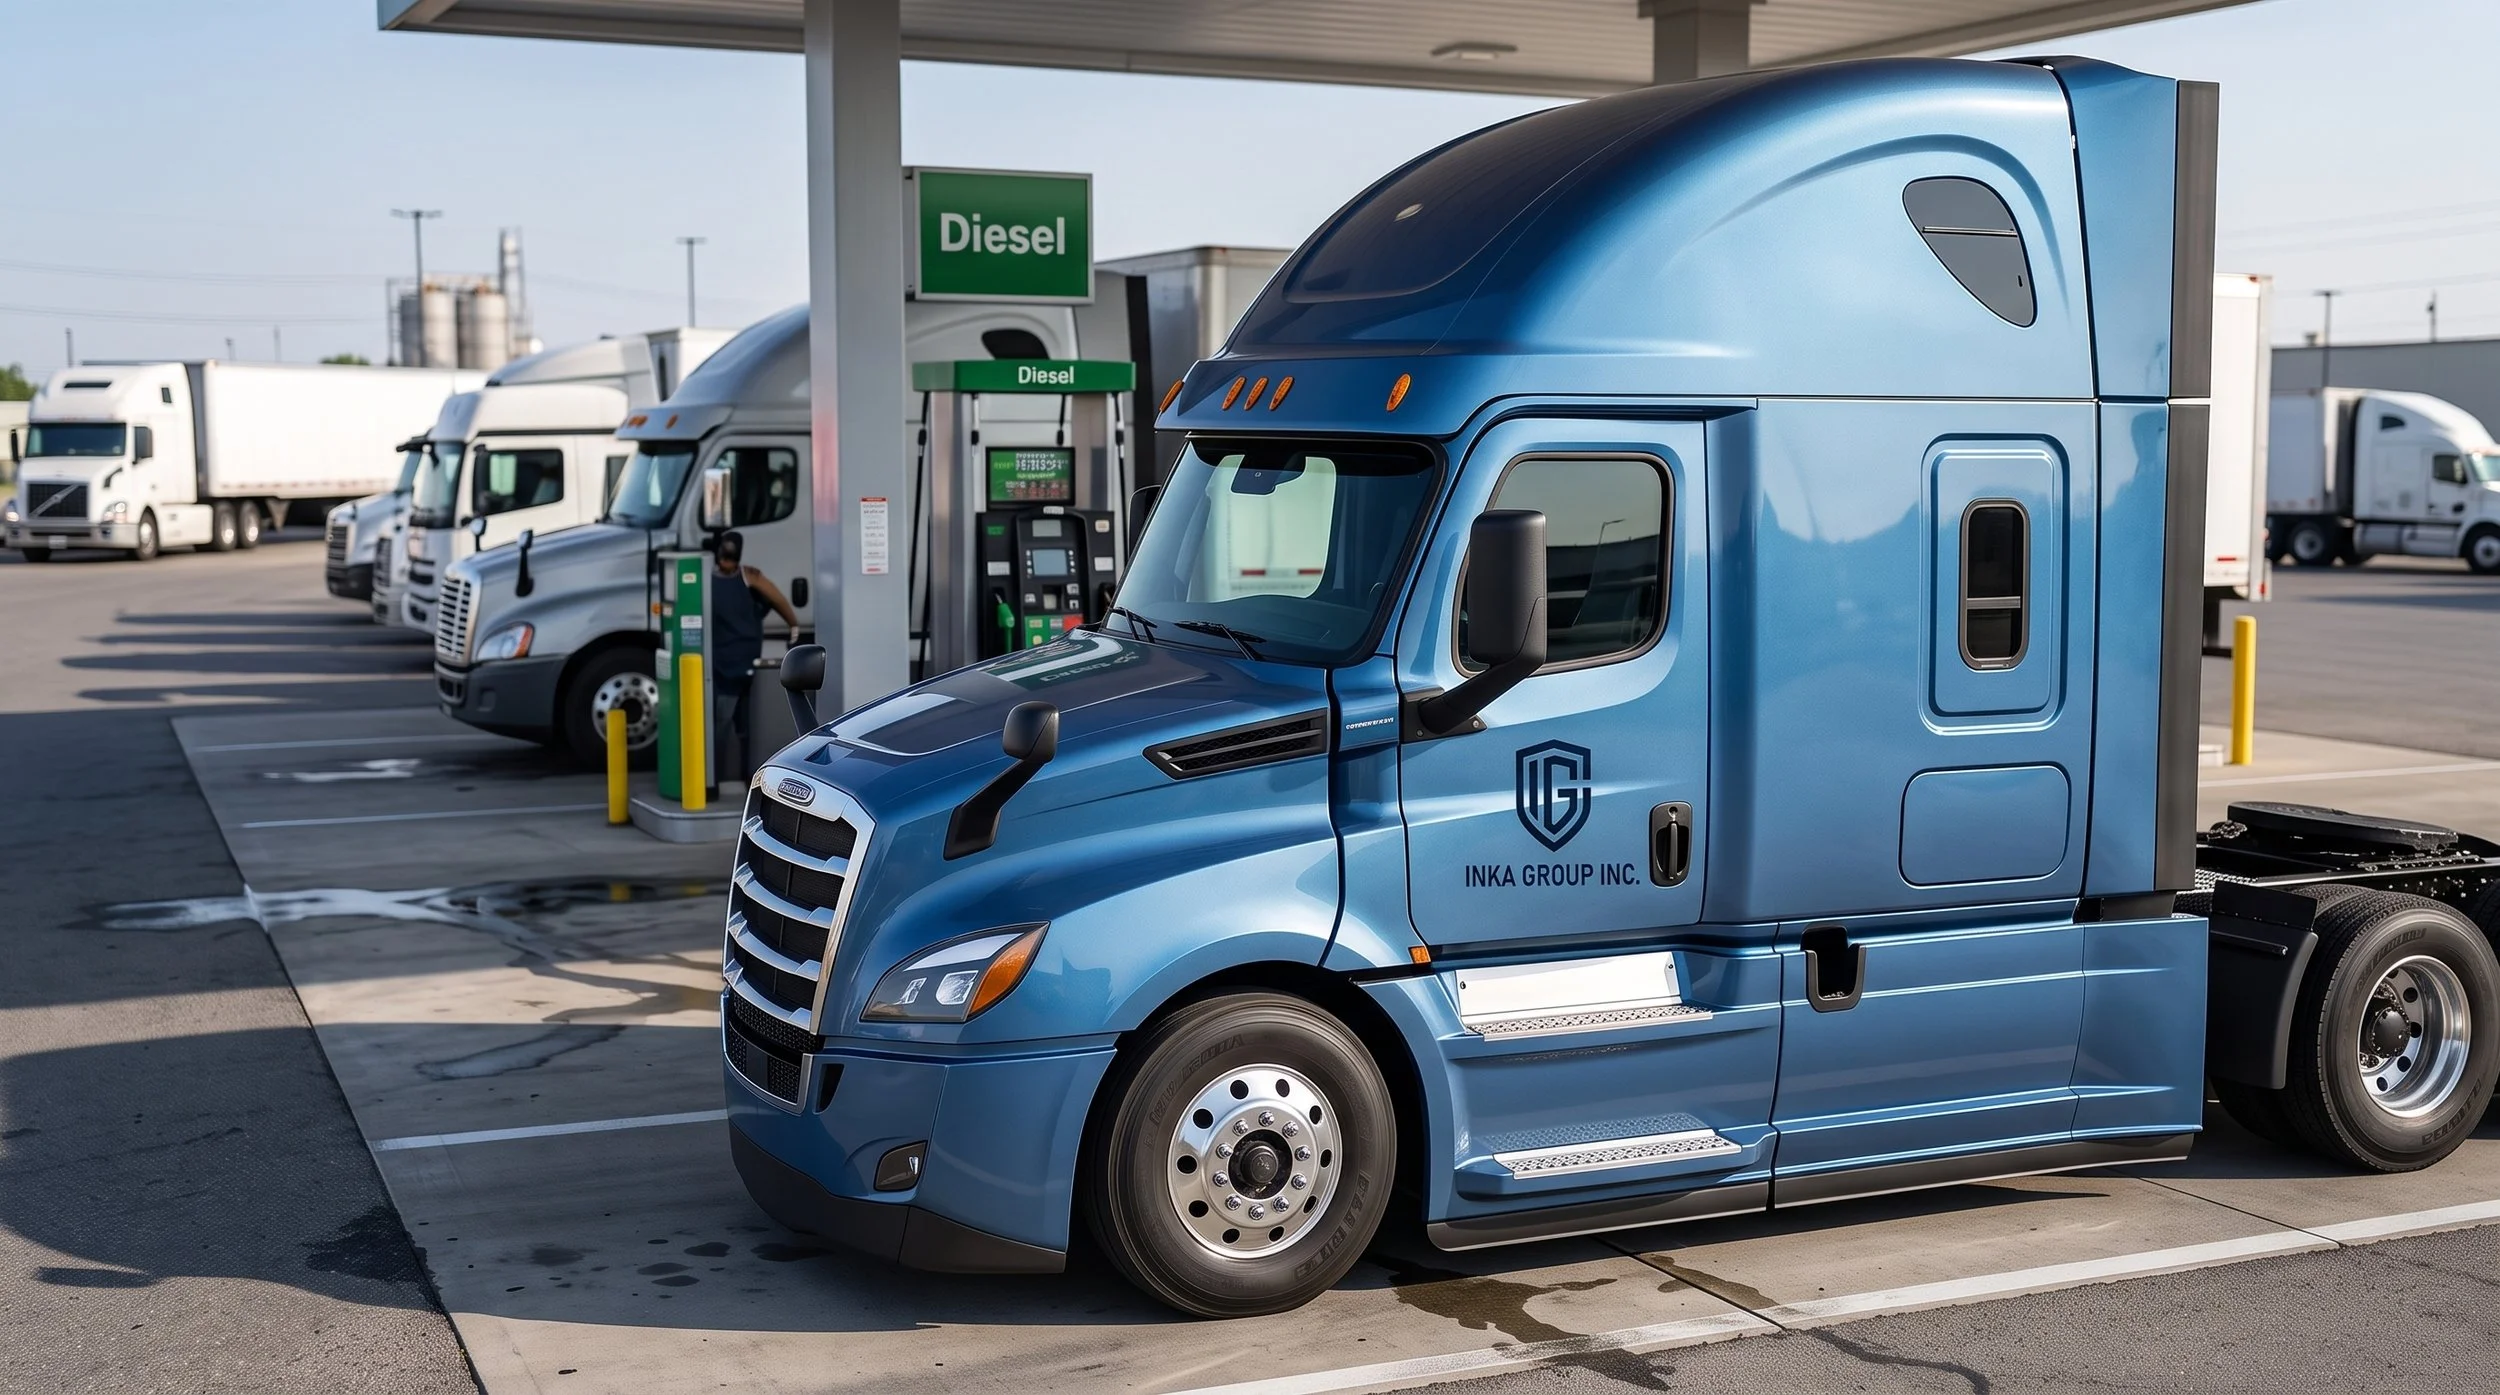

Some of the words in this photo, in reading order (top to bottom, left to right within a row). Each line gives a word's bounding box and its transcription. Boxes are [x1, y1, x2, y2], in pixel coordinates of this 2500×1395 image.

[940, 212, 1066, 256] Diesel
[1017, 365, 1075, 385] Diesel
[1465, 864, 1517, 888] INKA
[1521, 863, 1595, 887] GROUP
[1600, 862, 1641, 887] INC.
